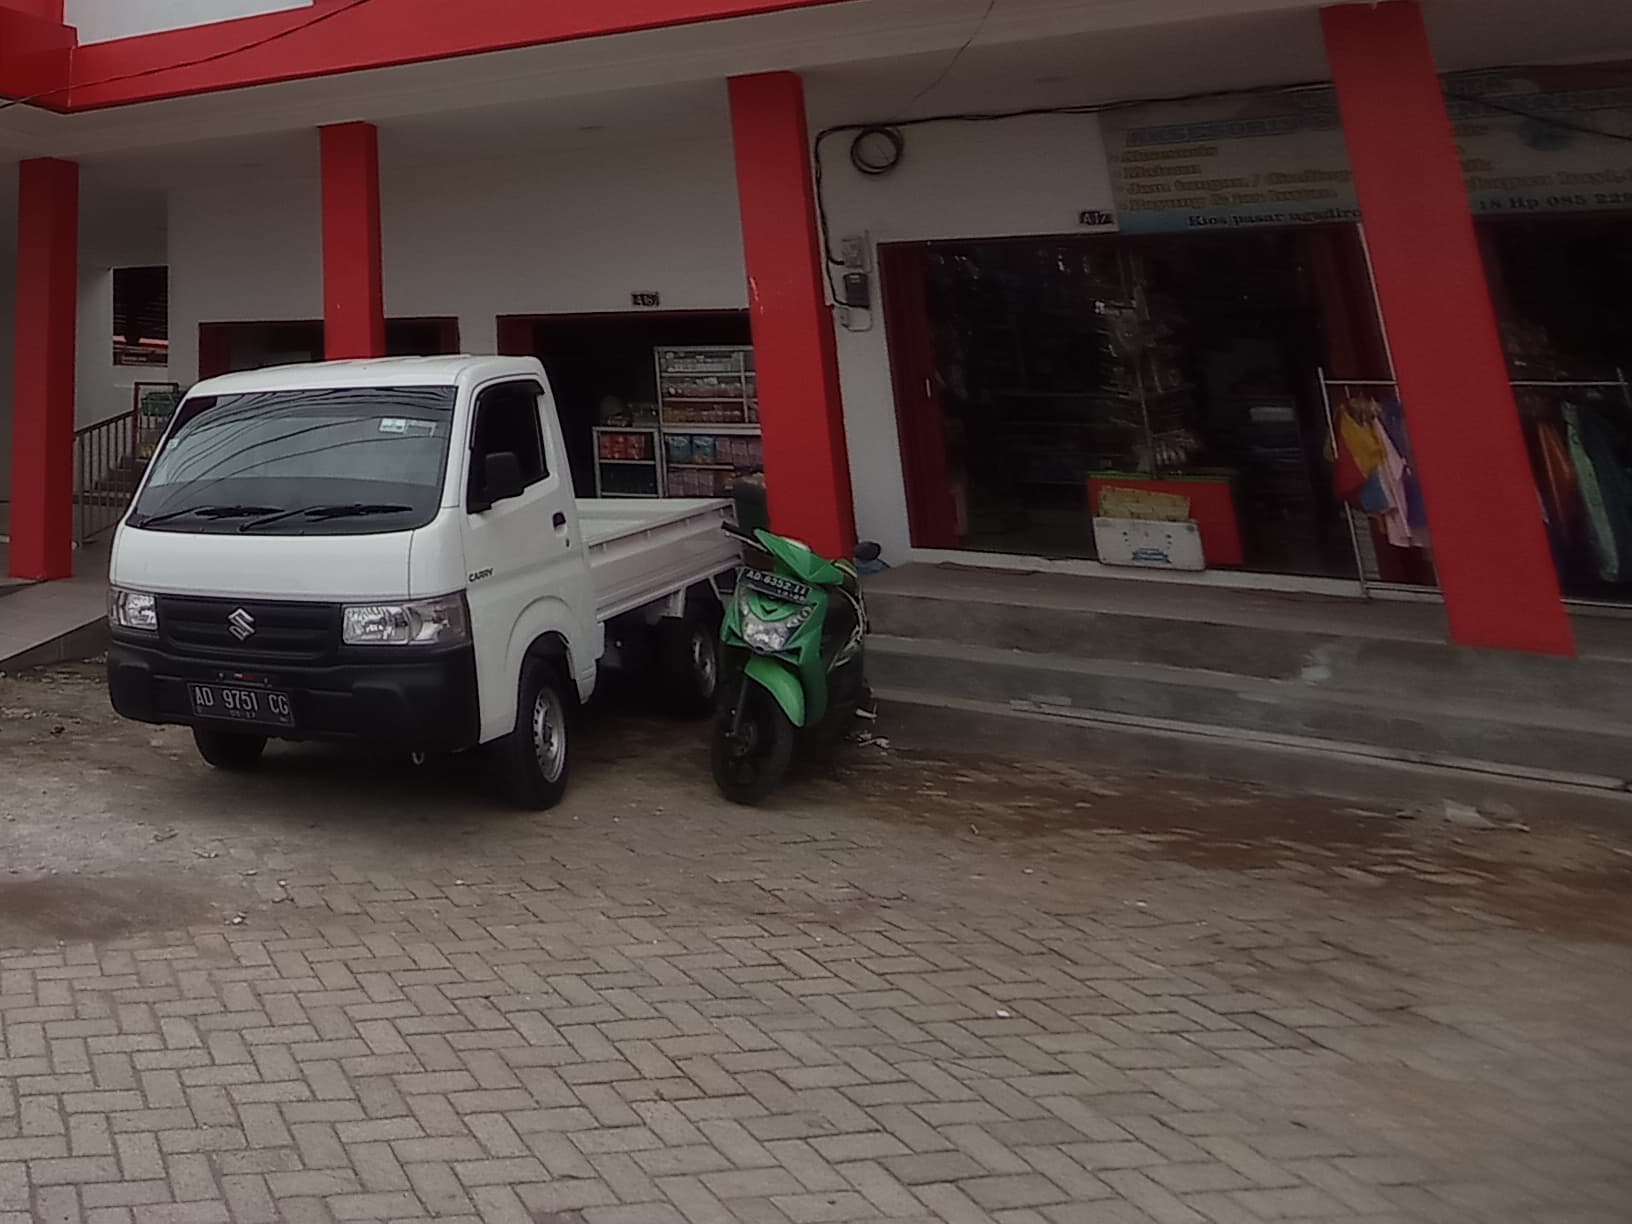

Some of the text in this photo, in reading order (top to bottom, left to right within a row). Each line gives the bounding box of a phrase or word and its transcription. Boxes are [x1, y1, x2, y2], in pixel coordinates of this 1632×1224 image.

[746, 570, 761, 581] AD
[195, 686, 214, 706] AD
[222, 689, 259, 712] 9751
[268, 694, 289, 715] CG
